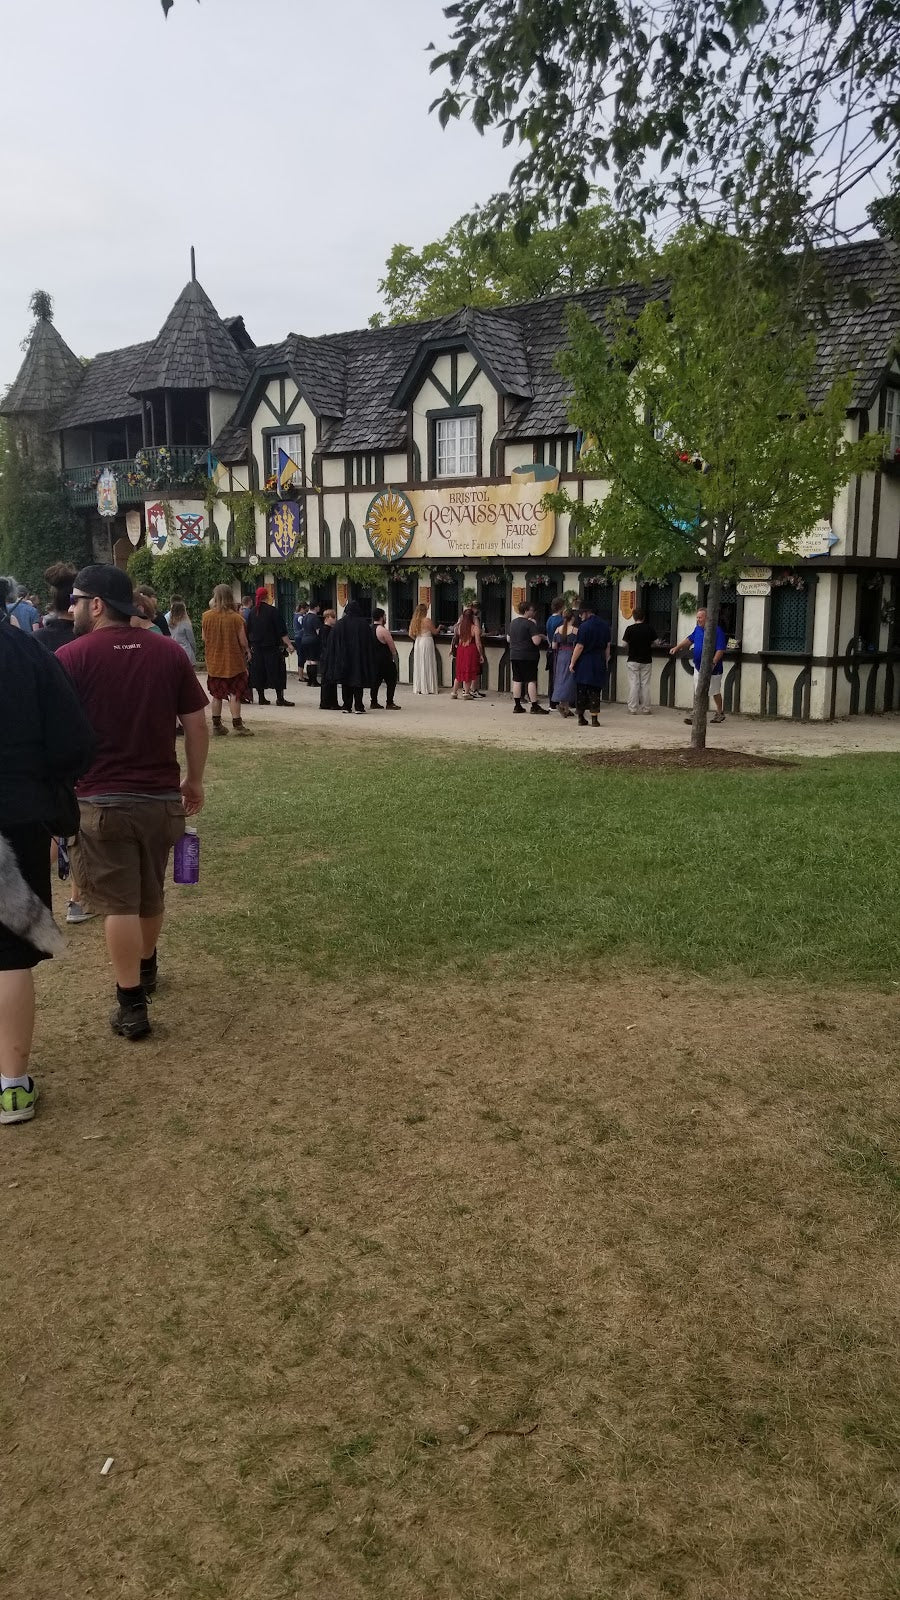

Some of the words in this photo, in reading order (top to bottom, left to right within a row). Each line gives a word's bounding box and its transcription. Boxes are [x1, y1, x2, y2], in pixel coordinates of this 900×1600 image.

[449, 491, 490, 504] BRISTOL
[423, 502, 548, 539] RENAISSANCE
[506, 523, 538, 537] FAIRE
[447, 539, 470, 550] Where
[471, 539, 498, 551] Fantasy
[501, 538, 524, 550] Rules!
